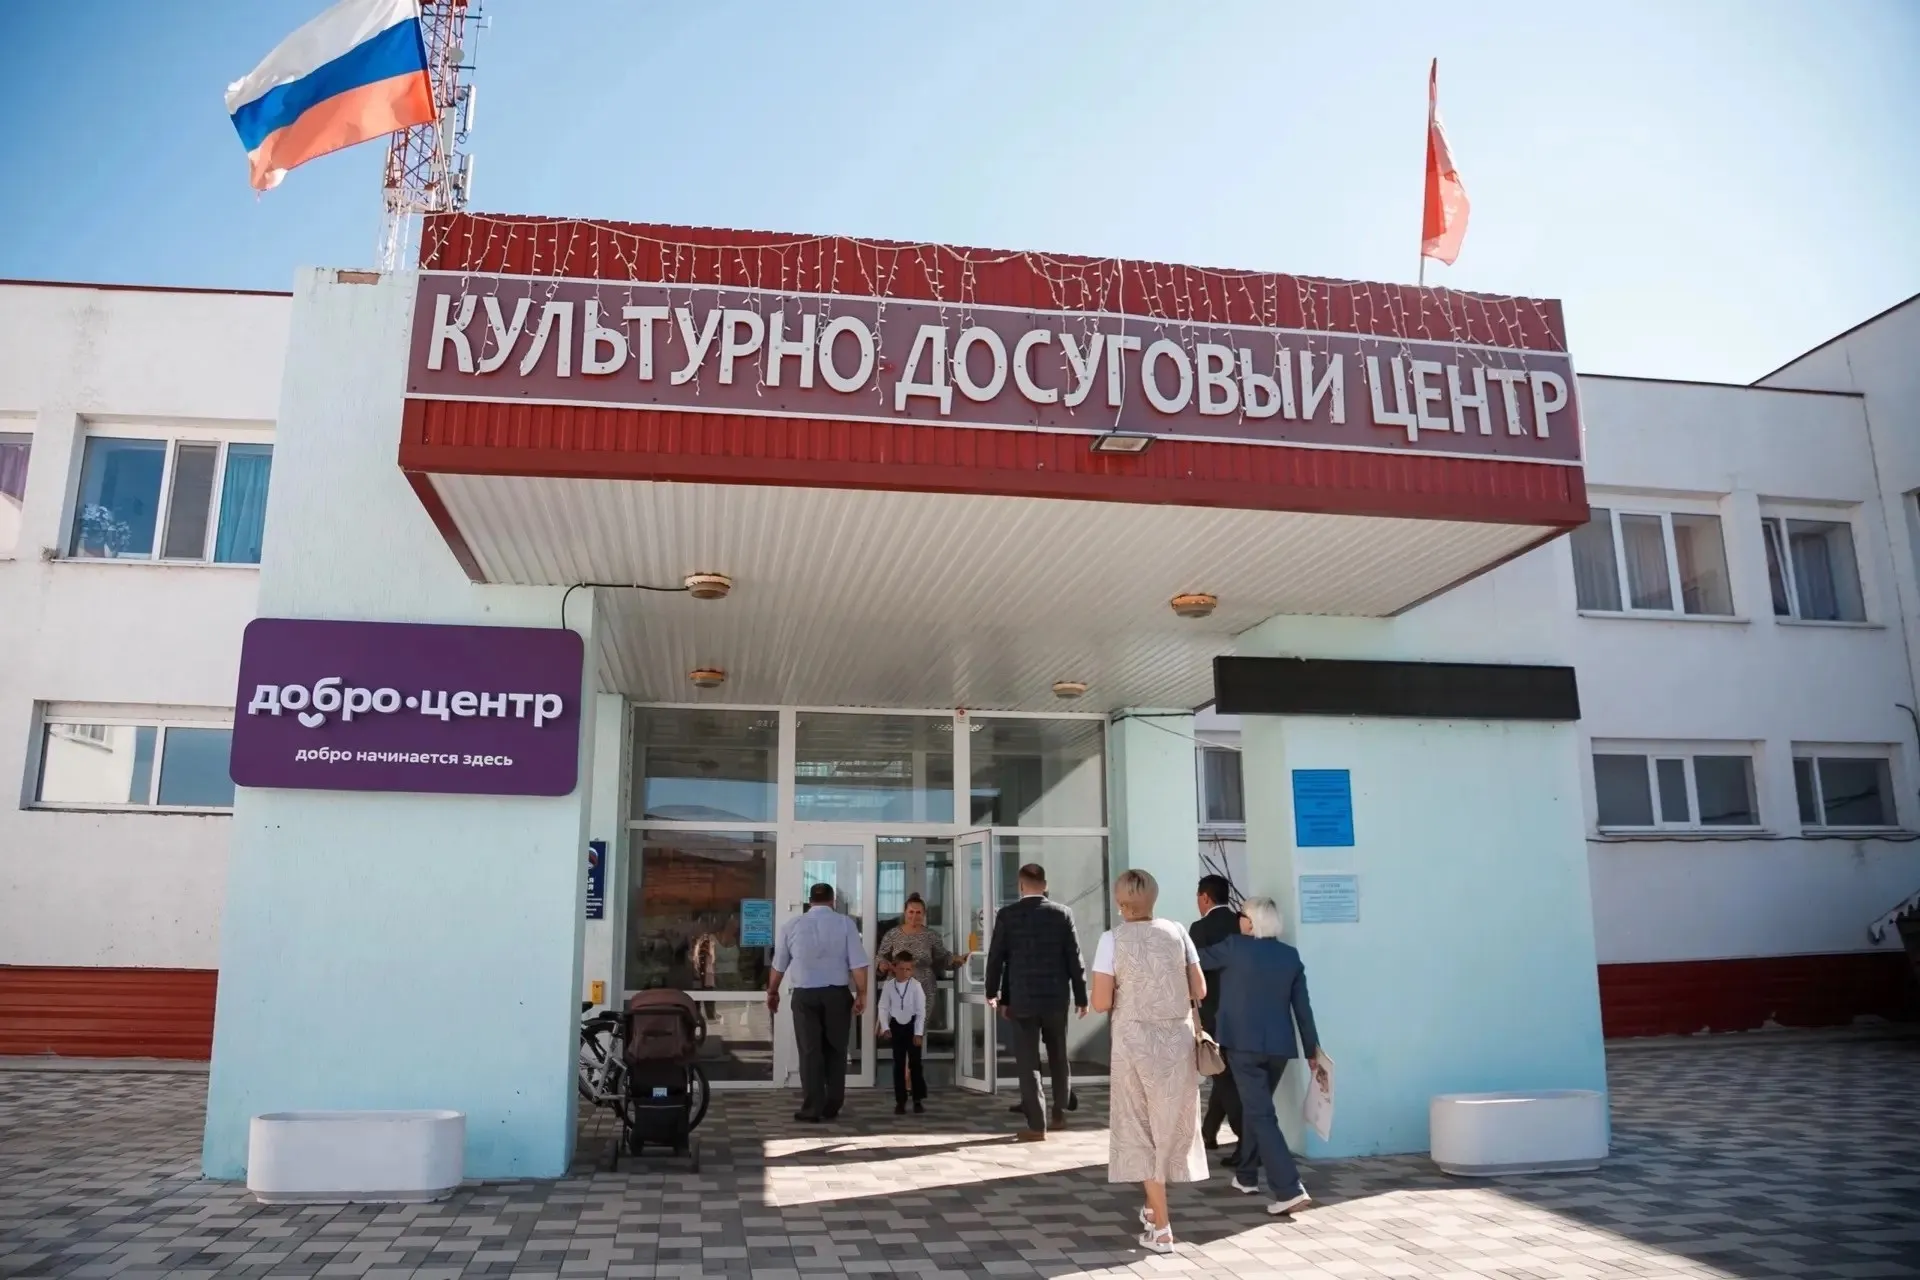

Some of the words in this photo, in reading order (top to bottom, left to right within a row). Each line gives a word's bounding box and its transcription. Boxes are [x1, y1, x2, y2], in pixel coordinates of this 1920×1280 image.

[427, 294, 876, 393] КУЛЬТУРНО
[1366, 355, 1569, 443] ЦЕНТР
[295, 747, 352, 764] добро
[356, 750, 459, 765] начинается
[462, 752, 513, 767] здесь
